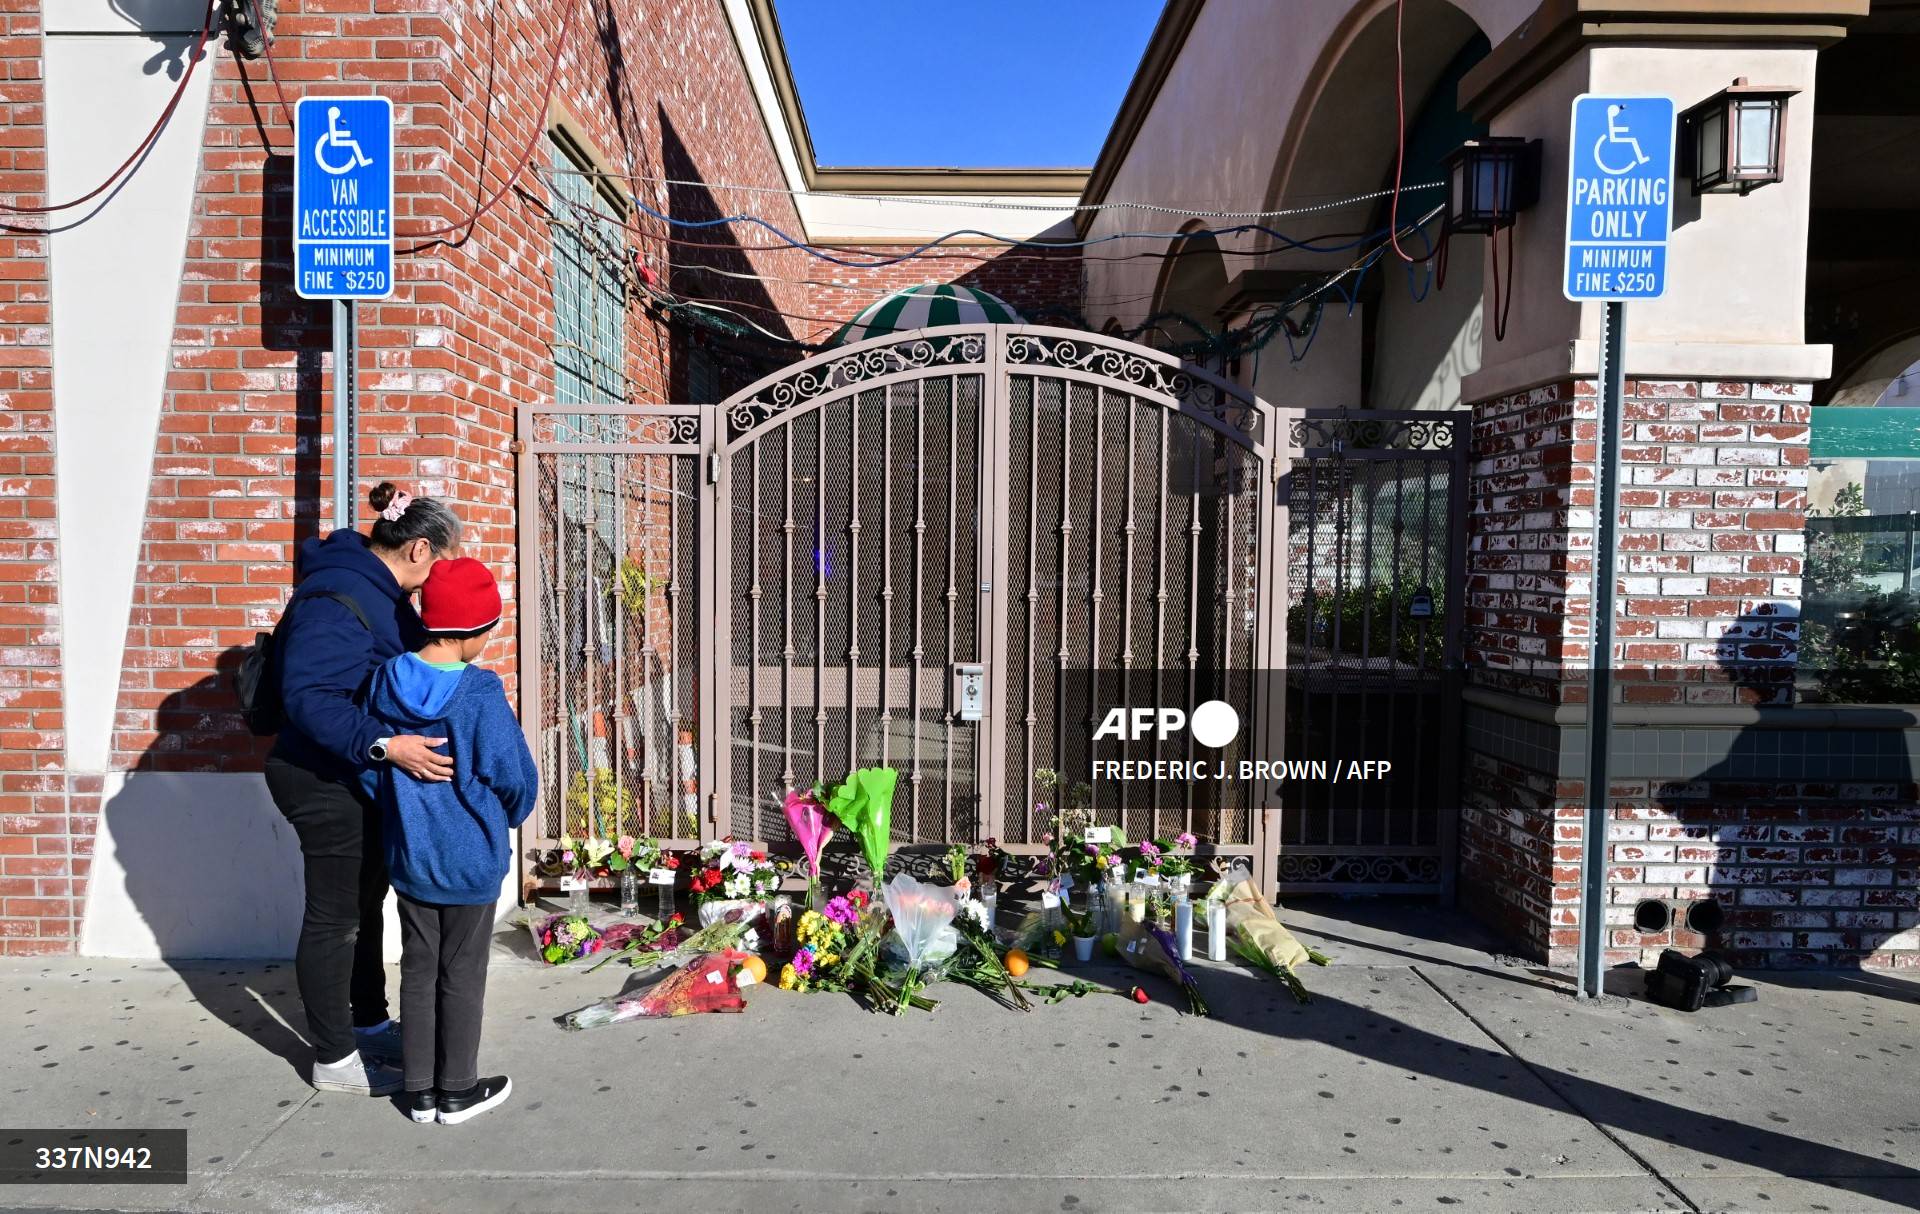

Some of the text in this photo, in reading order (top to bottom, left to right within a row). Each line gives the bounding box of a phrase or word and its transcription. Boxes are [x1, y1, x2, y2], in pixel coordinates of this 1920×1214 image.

[331, 178, 358, 206] VAN
[1575, 177, 1666, 206] PARKING
[302, 209, 386, 237] ACCESSIBLE
[1591, 210, 1647, 238] ONLY
[314, 248, 375, 266] MINIMUM
[1582, 249, 1652, 268] MINIMUM
[304, 269, 385, 292] FINE $250
[1576, 272, 1655, 294] FINE $250
